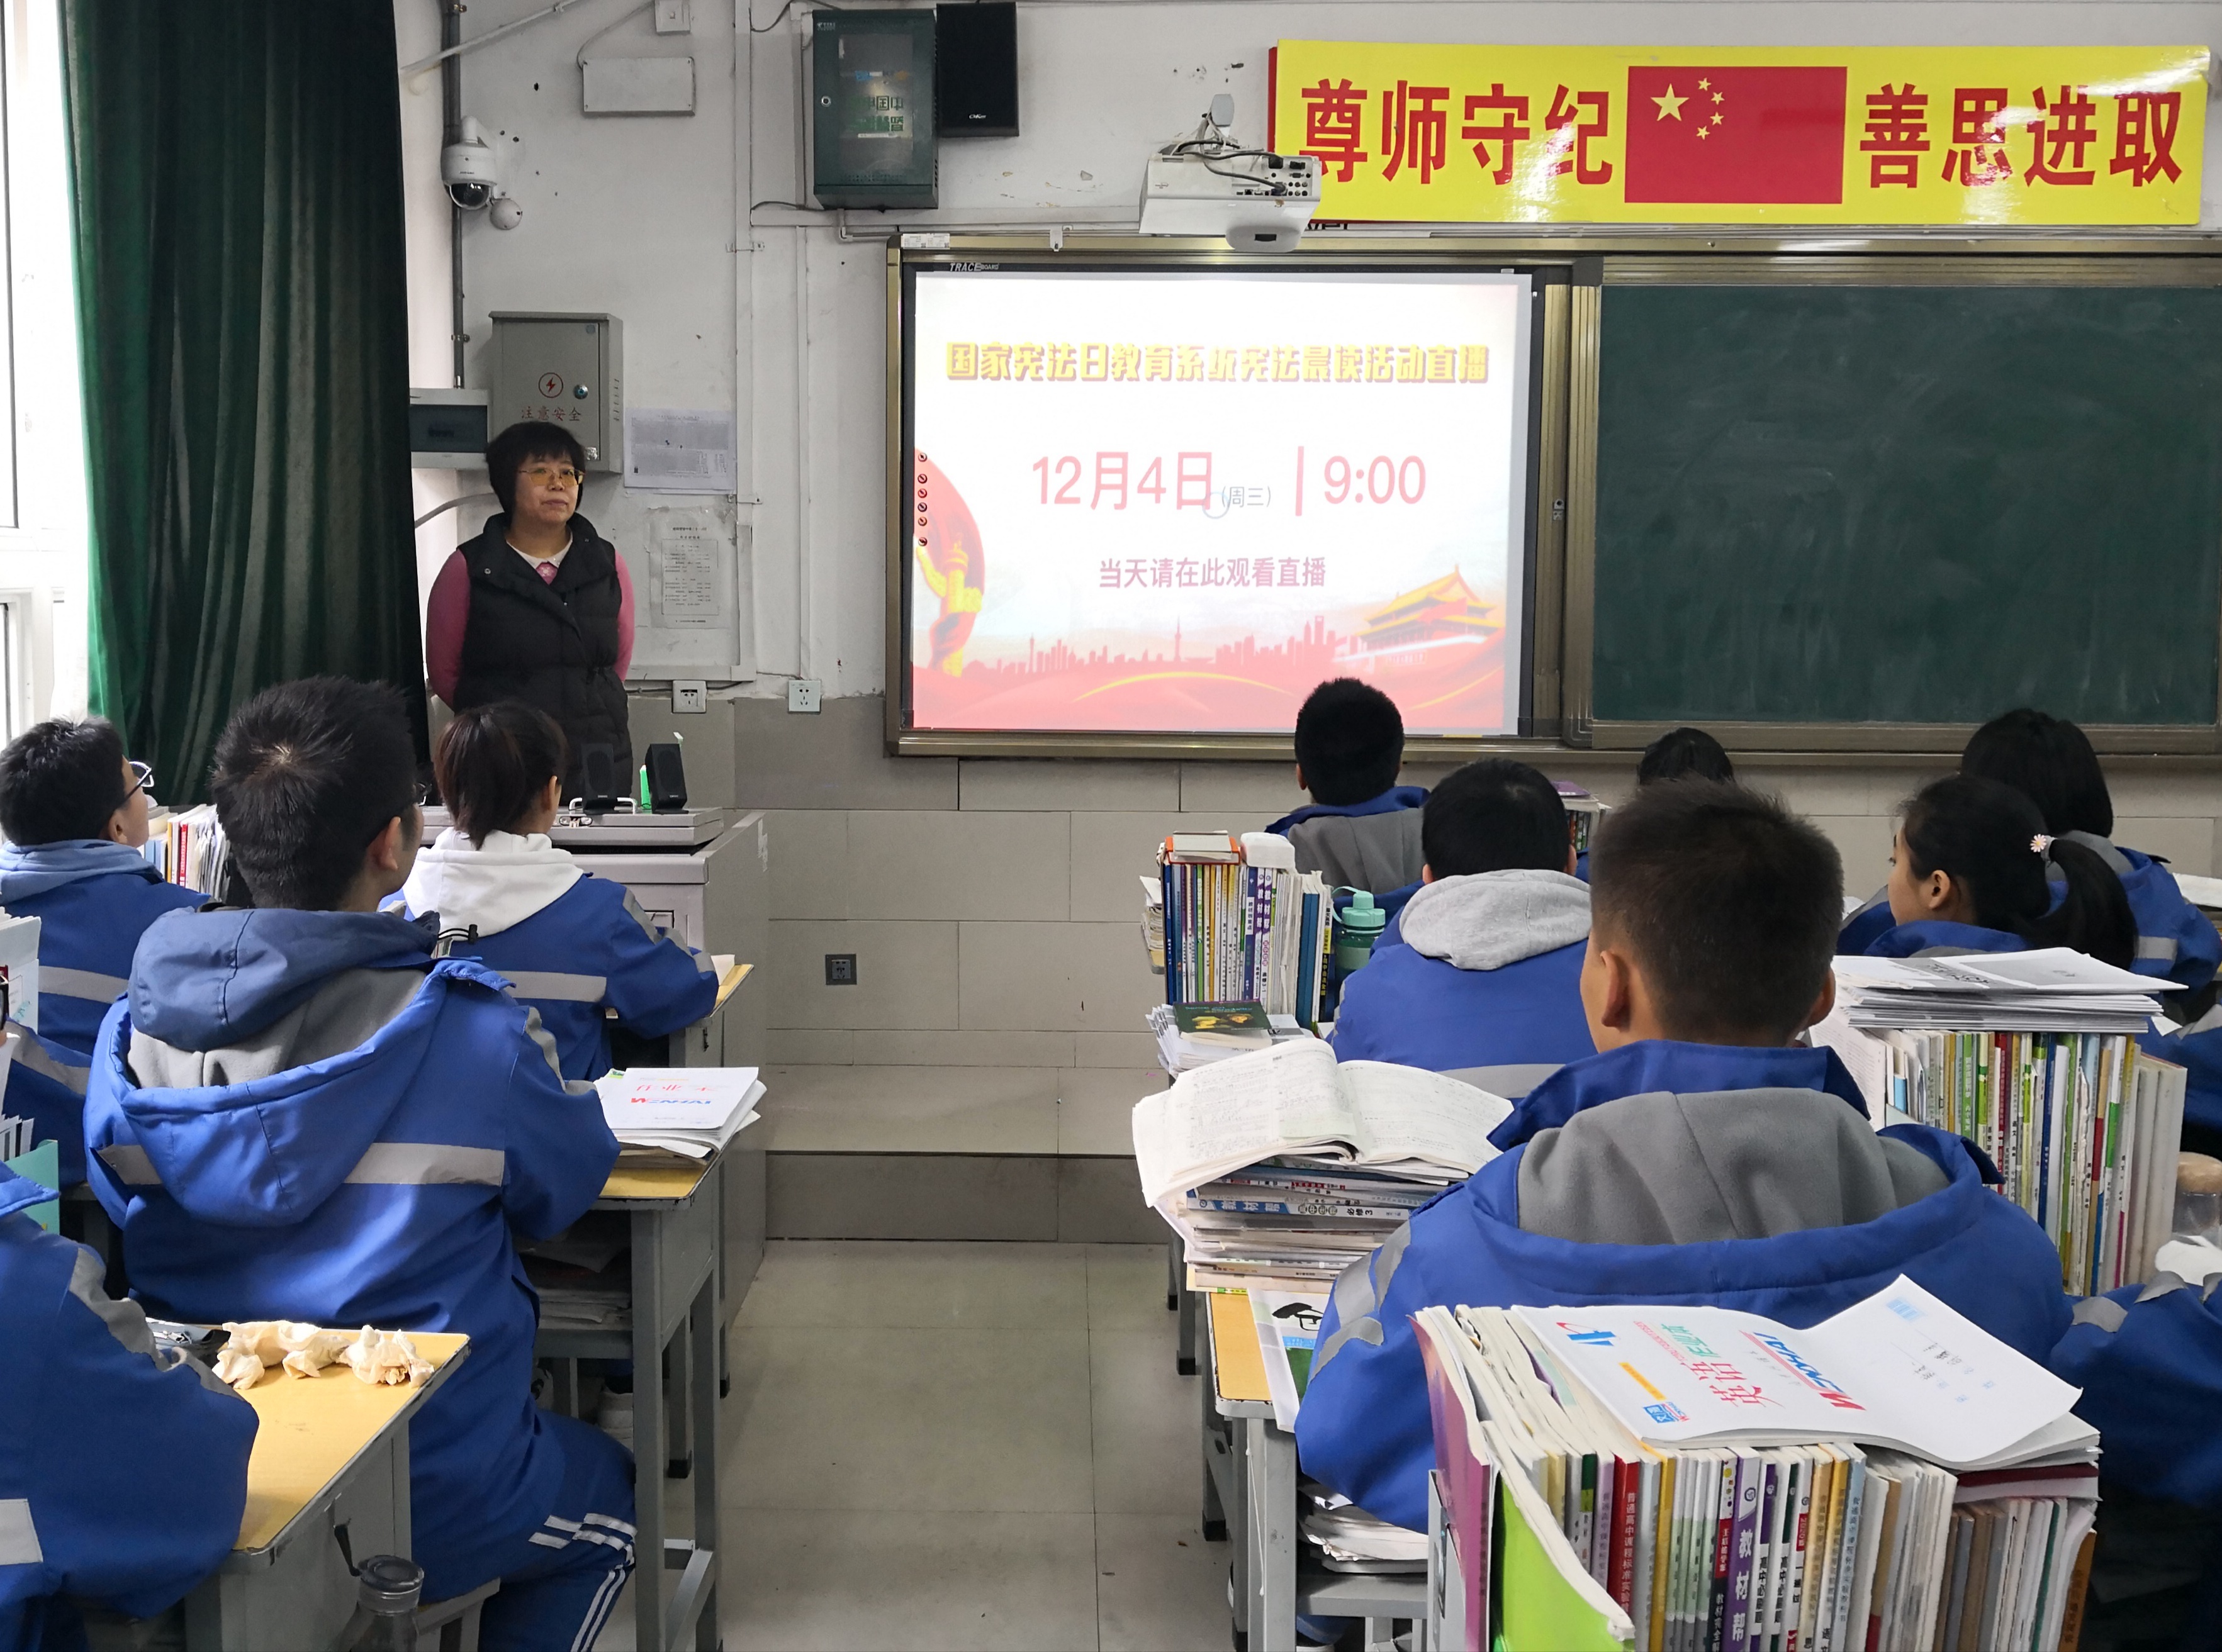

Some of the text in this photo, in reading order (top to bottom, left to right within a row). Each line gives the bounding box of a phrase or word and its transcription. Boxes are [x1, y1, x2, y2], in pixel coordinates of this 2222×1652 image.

[1299, 79, 1613, 186] 尊师守纪
[1860, 82, 2183, 188] 善思进取
[521, 406, 581, 421] 注意安全
[1033, 451, 1213, 511] 12月4日
[1323, 455, 1427, 505] 9:00
[1099, 556, 1327, 589] 当天请在此观看直播
[1680, 1361, 1786, 1409] 英语
[1732, 1529, 1753, 1642] 教材帮
